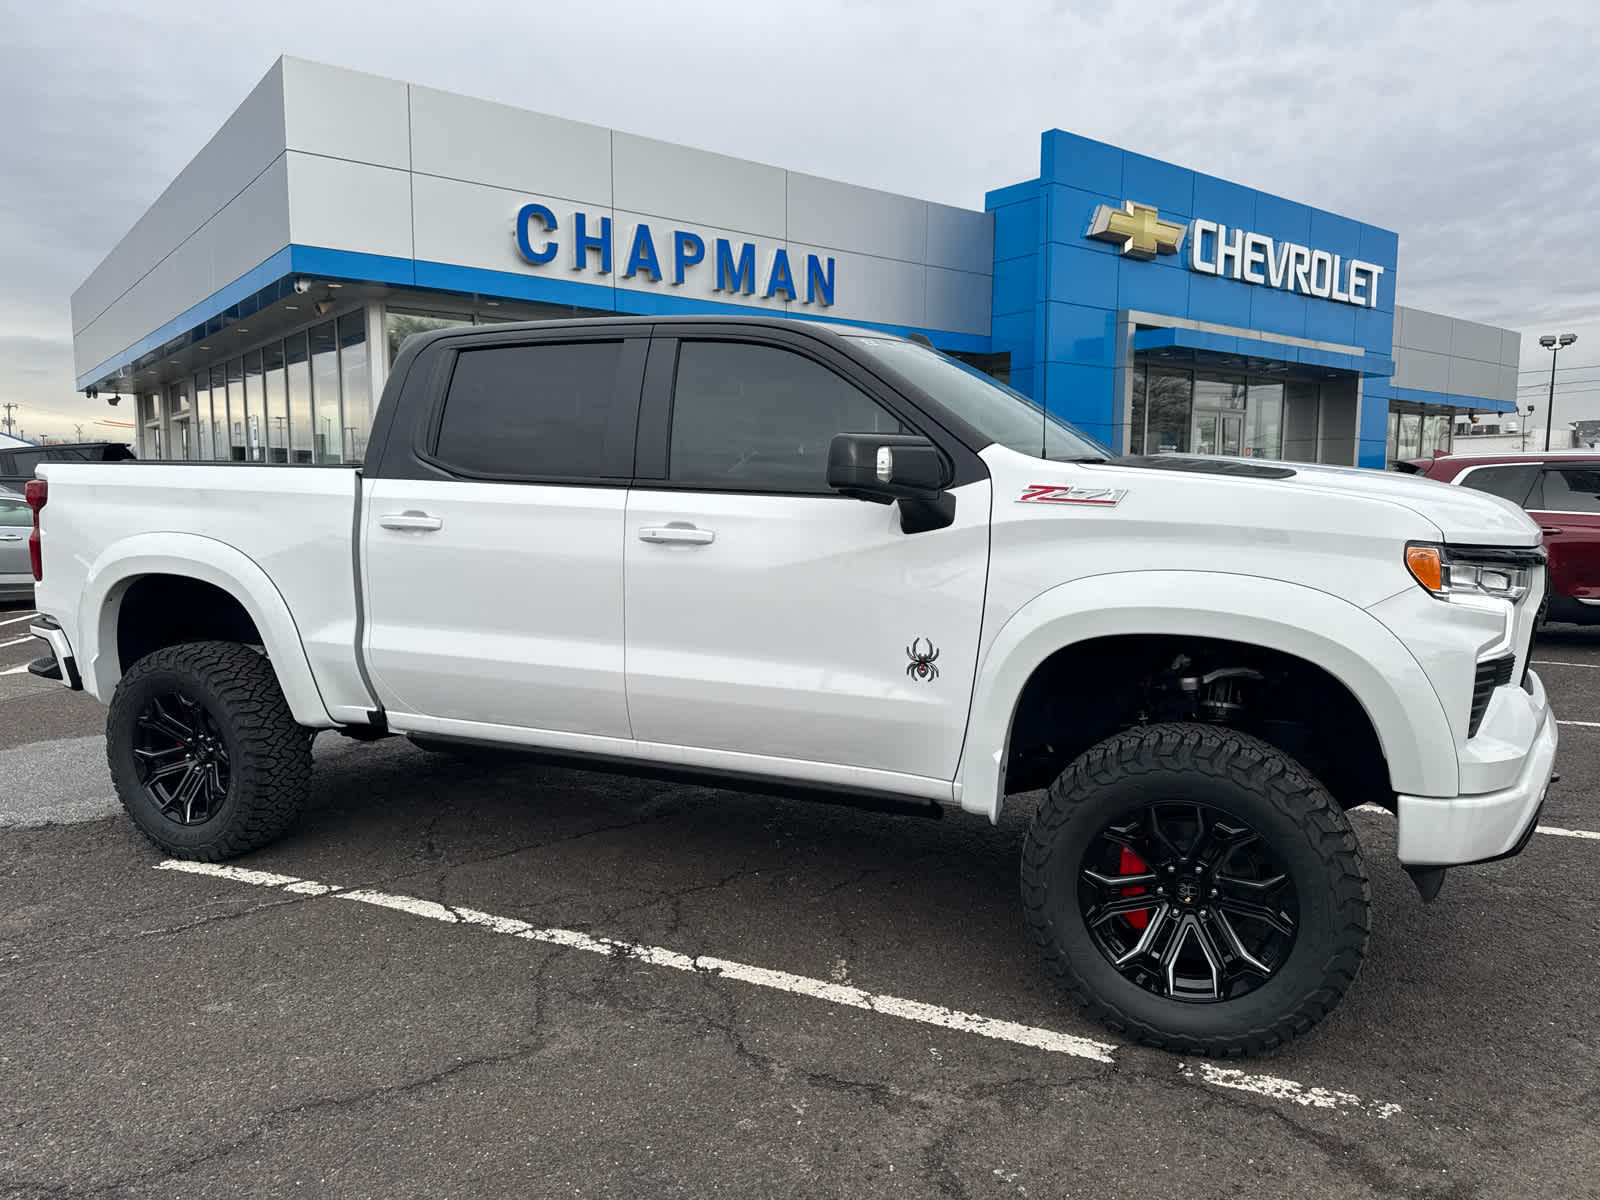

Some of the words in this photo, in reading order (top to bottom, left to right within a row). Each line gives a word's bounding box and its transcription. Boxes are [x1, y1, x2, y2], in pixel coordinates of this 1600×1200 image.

[514, 202, 835, 307] CHAPMAN
[1191, 218, 1384, 308] CHEVROLET
[1015, 484, 1128, 508] Z71
